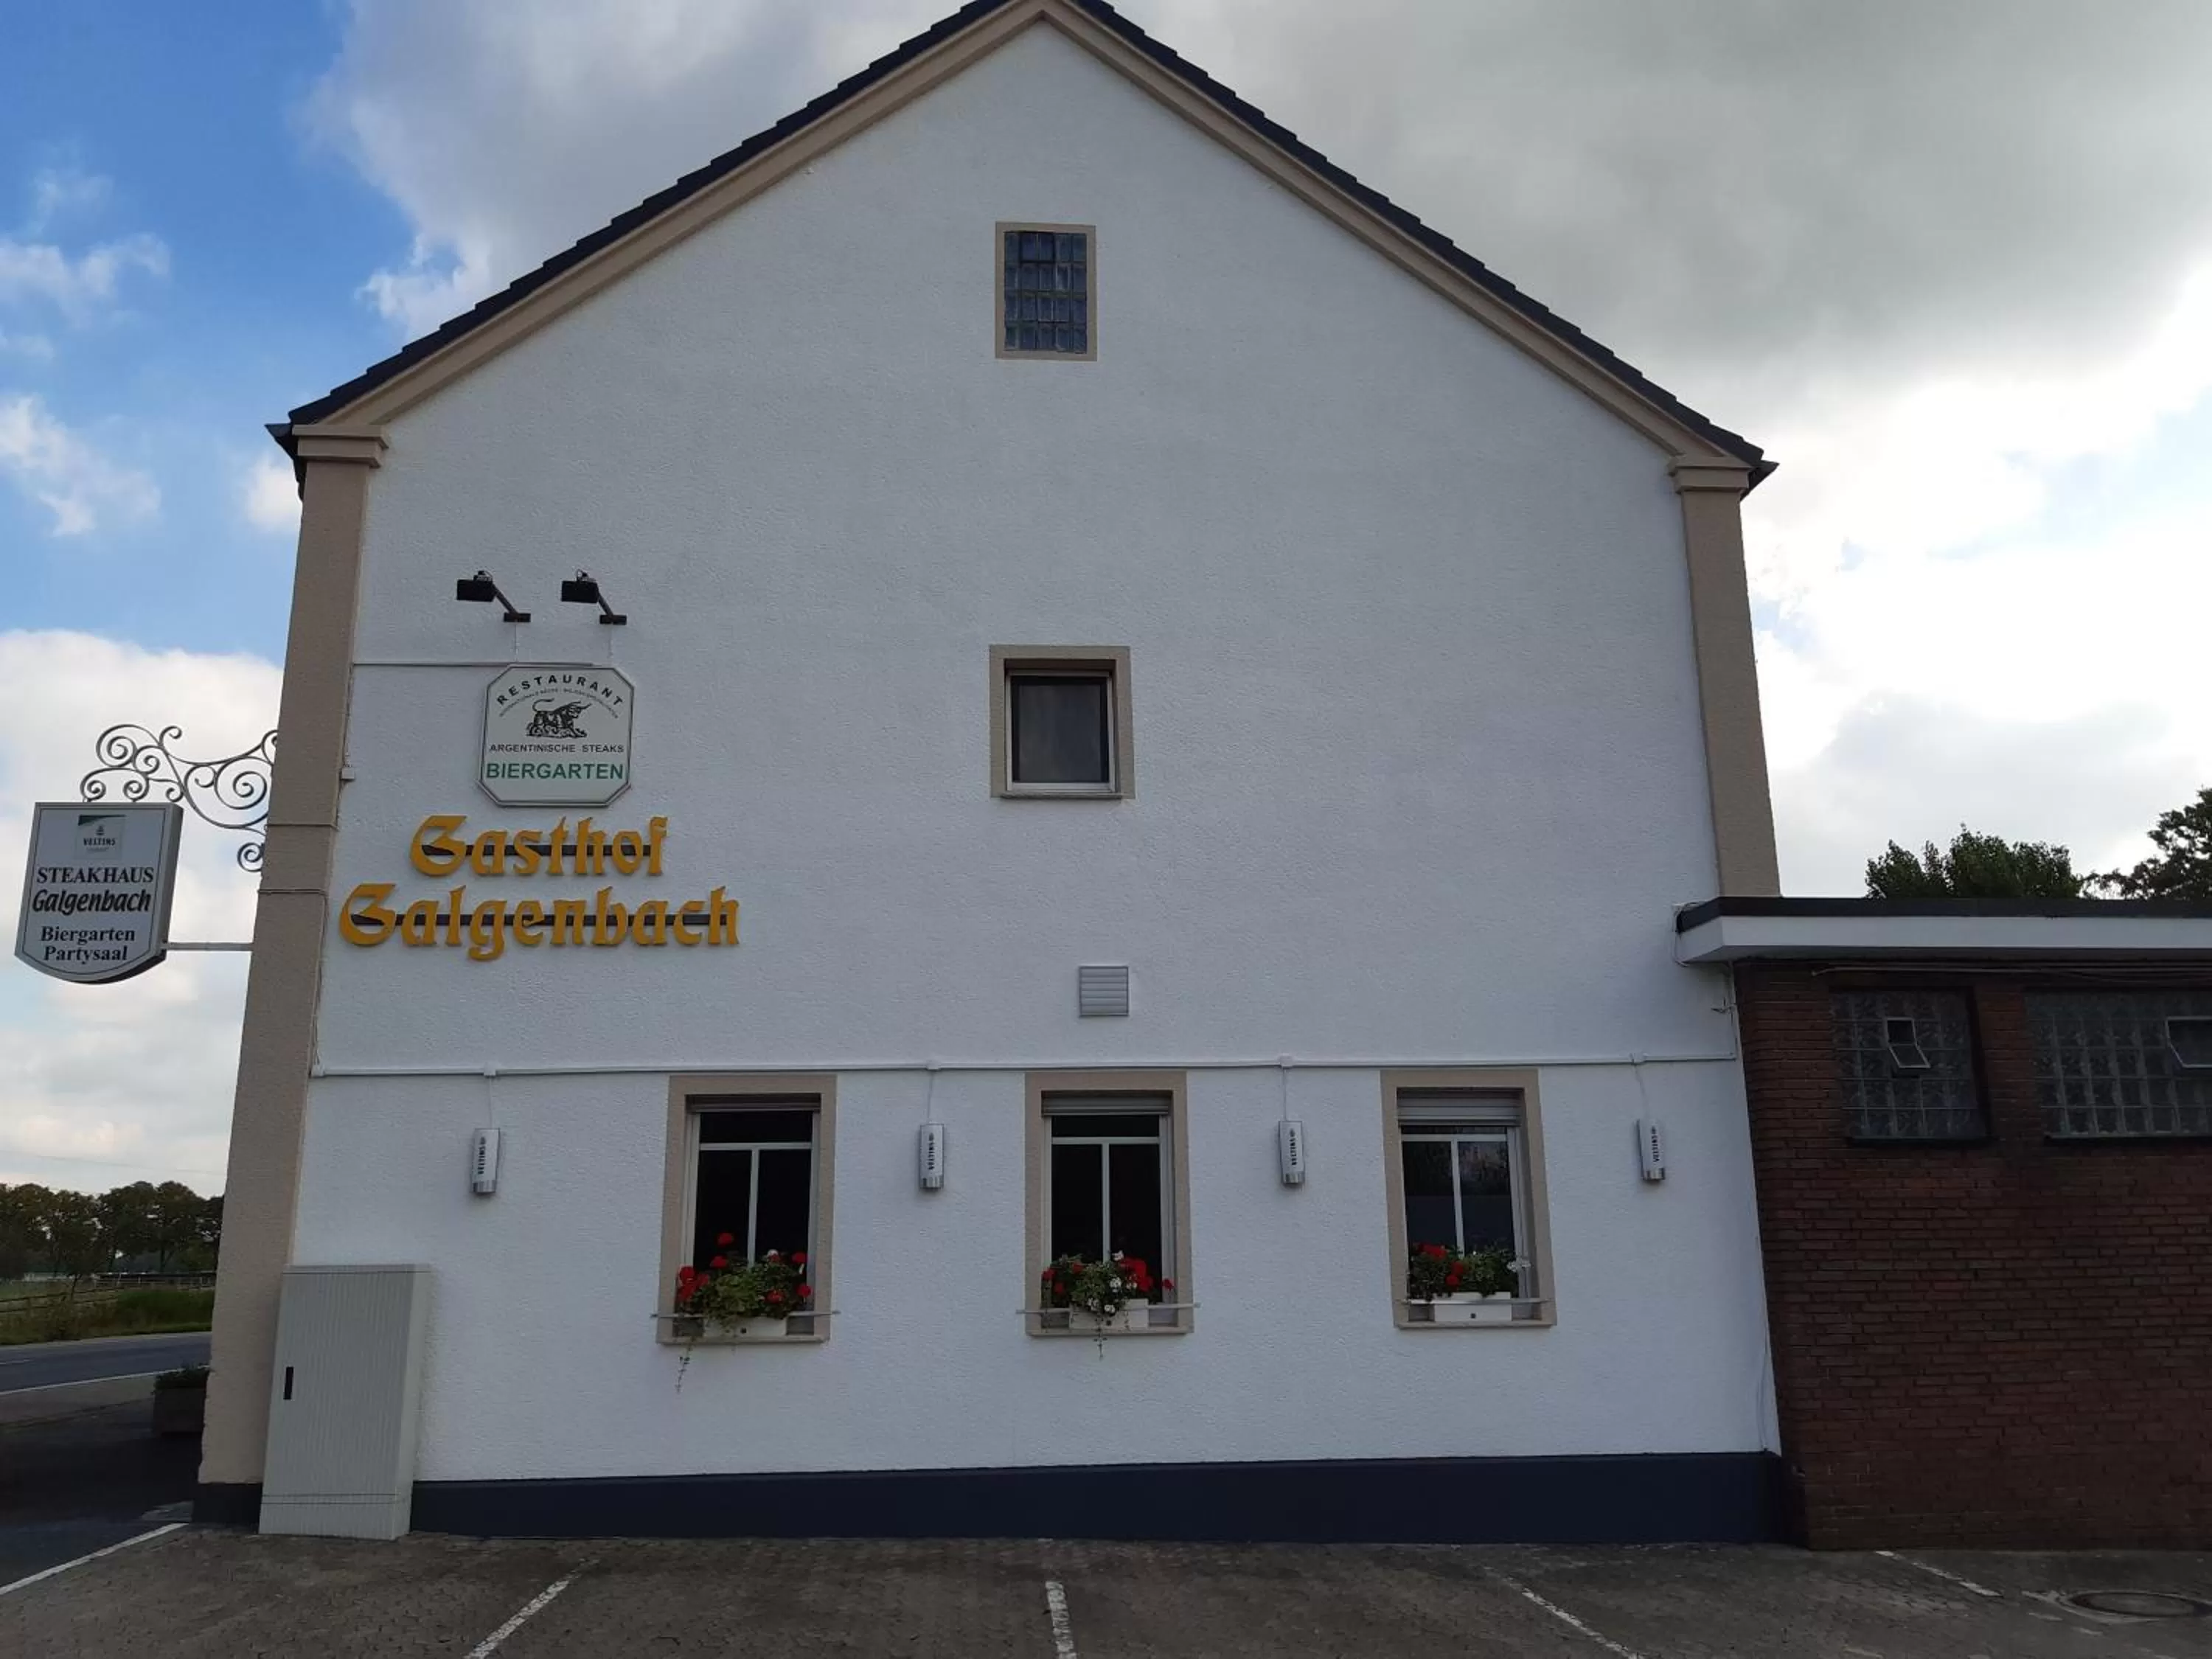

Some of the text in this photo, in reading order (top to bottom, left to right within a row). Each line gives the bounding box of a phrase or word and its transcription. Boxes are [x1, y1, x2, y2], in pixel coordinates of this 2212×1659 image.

[497, 674, 623, 706] RESTAURANT
[490, 744, 625, 755] ARGENTINISCHE STEAKS
[486, 762, 624, 780] BIERGARTEN
[410, 815, 669, 877] Gasthof
[36, 866, 155, 883] STEAKHAUS
[32, 888, 152, 916] Galgenbach
[339, 883, 740, 962] Galgenbach
[41, 926, 136, 945] Biergarten
[44, 945, 128, 965] Partysaal
